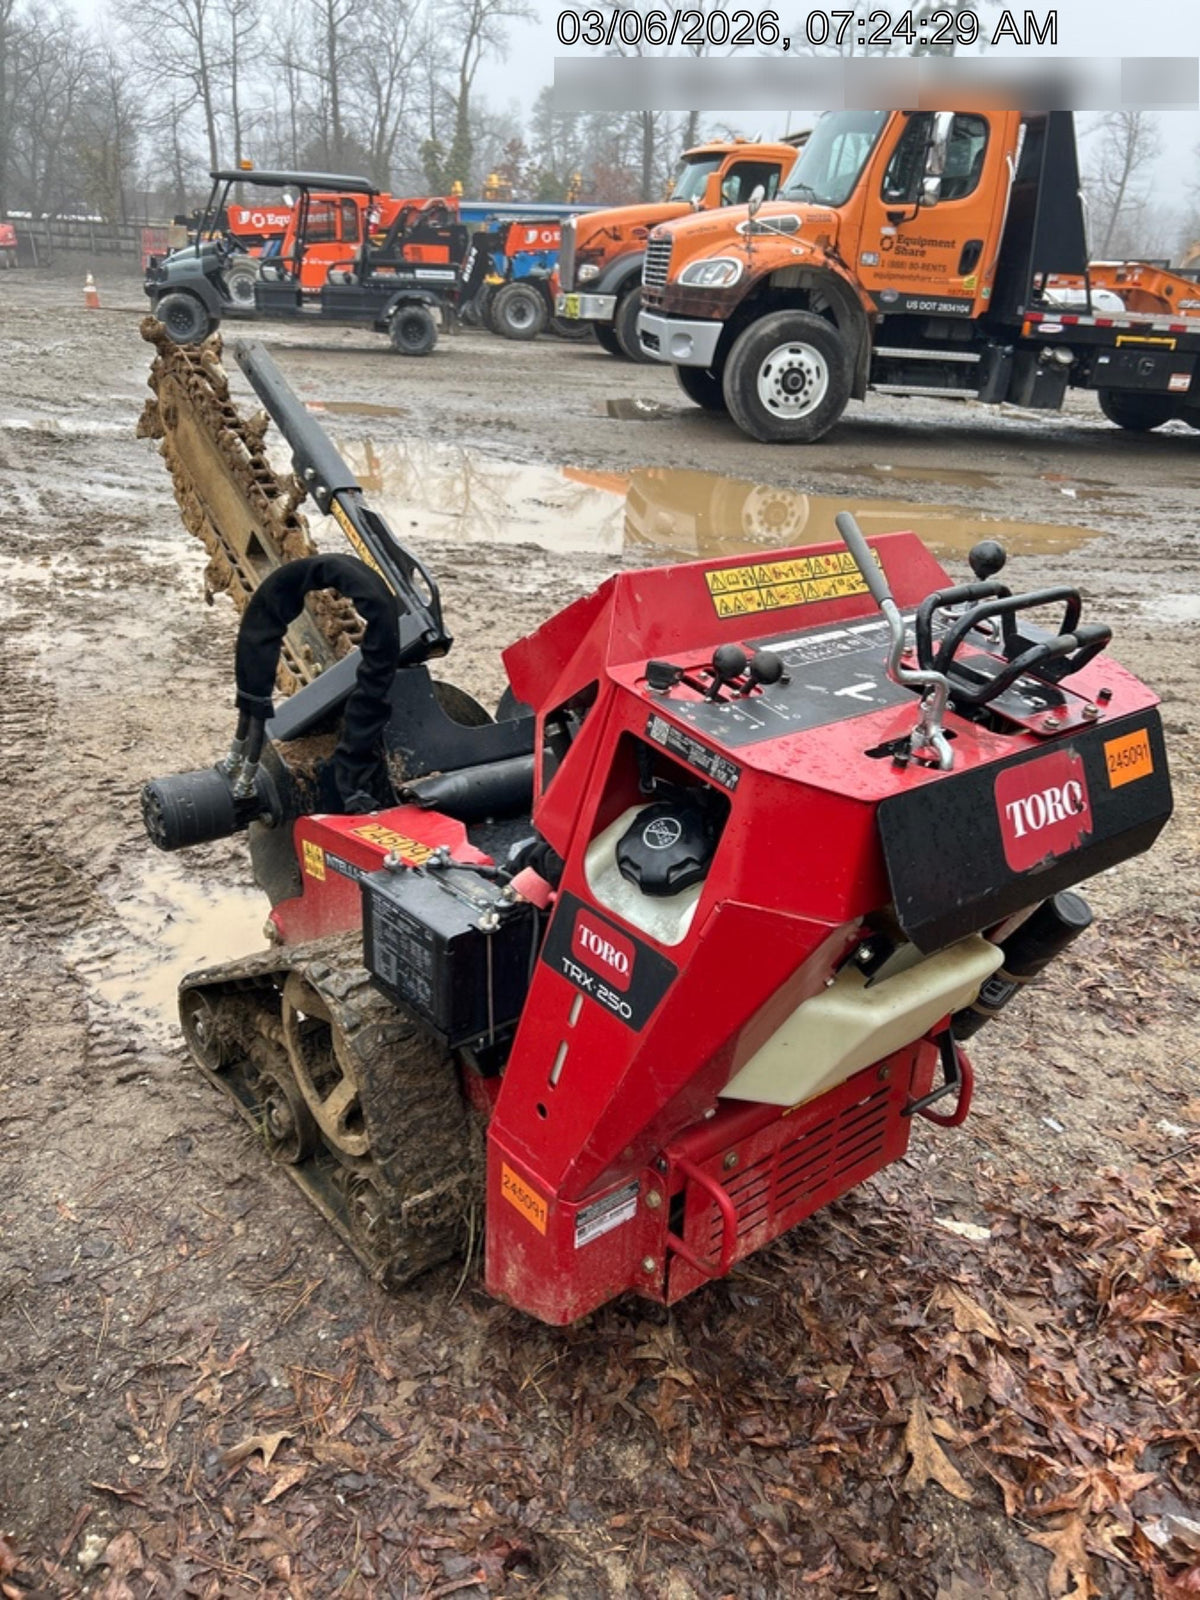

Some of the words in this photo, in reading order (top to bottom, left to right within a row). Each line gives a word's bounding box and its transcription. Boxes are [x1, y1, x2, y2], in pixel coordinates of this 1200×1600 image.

[894, 245, 926, 257] Share
[897, 235, 956, 248] Equipment
[906, 300, 918, 310] US
[919, 301, 937, 311] DOT
[1108, 744, 1149, 773] 245091
[1005, 780, 1084, 838] TORO
[578, 924, 630, 974] TORO
[503, 1174, 546, 1223] 245091
